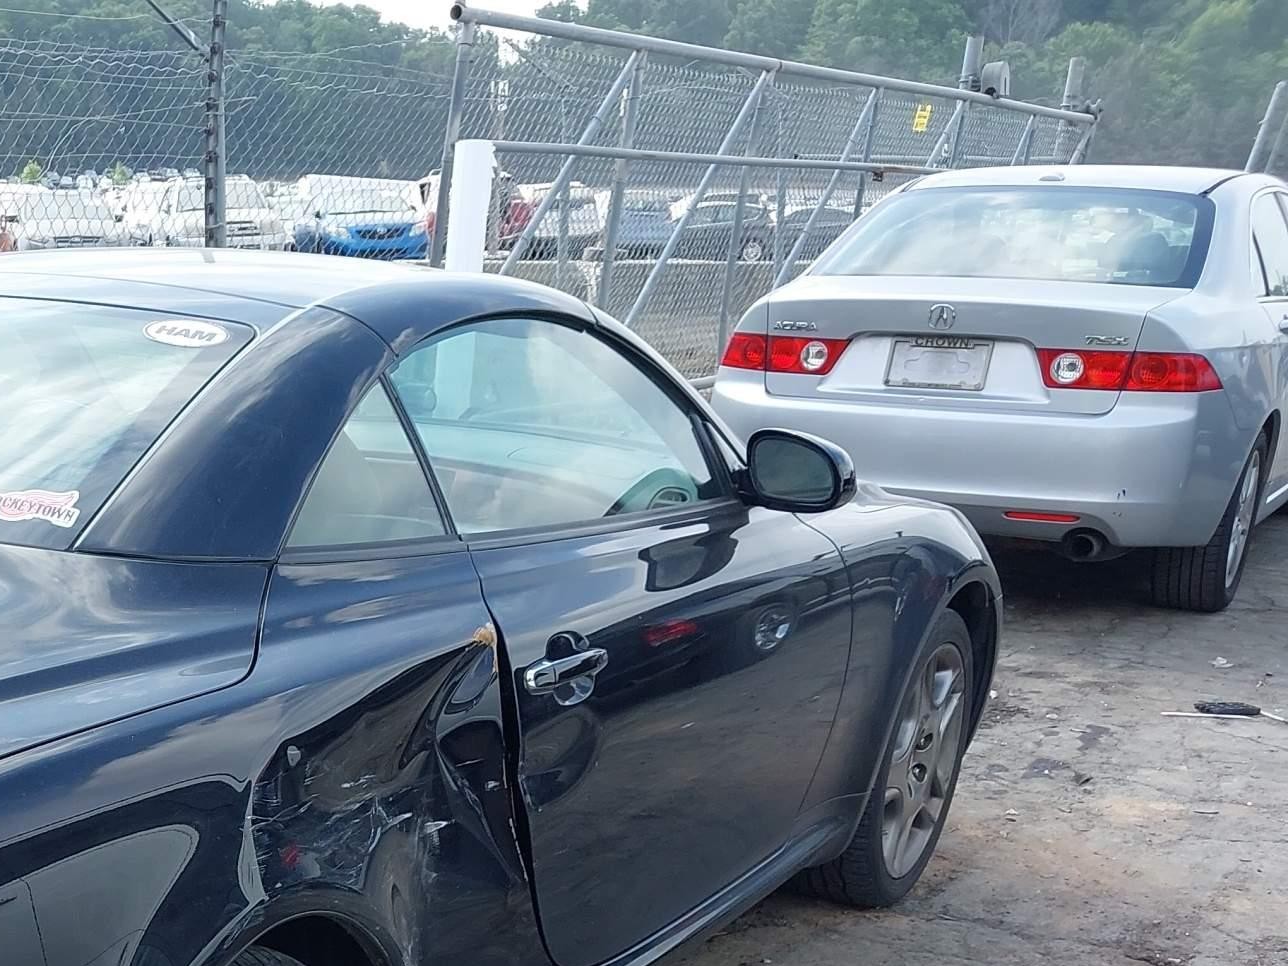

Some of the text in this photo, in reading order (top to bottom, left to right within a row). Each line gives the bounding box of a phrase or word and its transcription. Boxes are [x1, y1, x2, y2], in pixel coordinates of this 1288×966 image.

[774, 319, 817, 331] ACURA
[155, 324, 218, 342] HAM
[914, 336, 970, 347] CROWN
